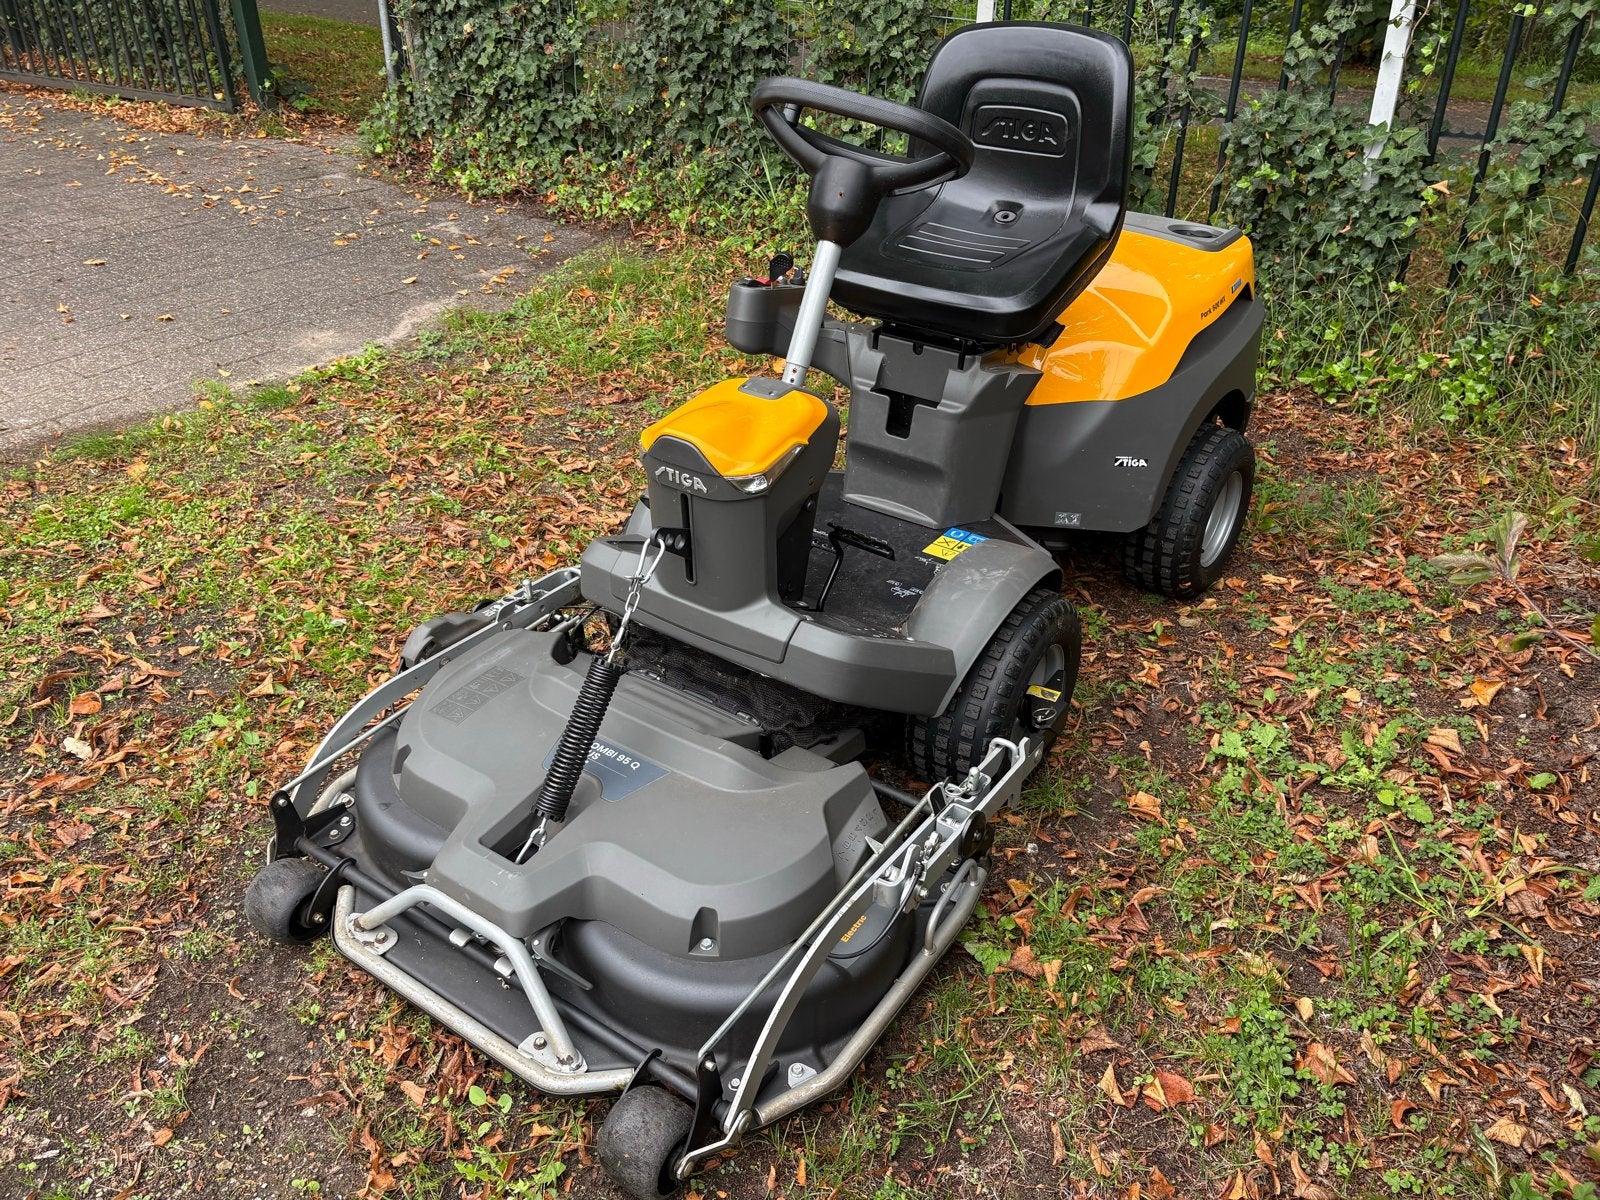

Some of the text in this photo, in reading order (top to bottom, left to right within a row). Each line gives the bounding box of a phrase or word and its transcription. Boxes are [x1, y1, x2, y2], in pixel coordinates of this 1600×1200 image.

[980, 116, 1058, 146] STIGA
[1114, 456, 1148, 467] STIGA
[655, 466, 708, 494] STIGA
[590, 742, 641, 771] OMBI 95 Q
[840, 914, 867, 943] Electric
